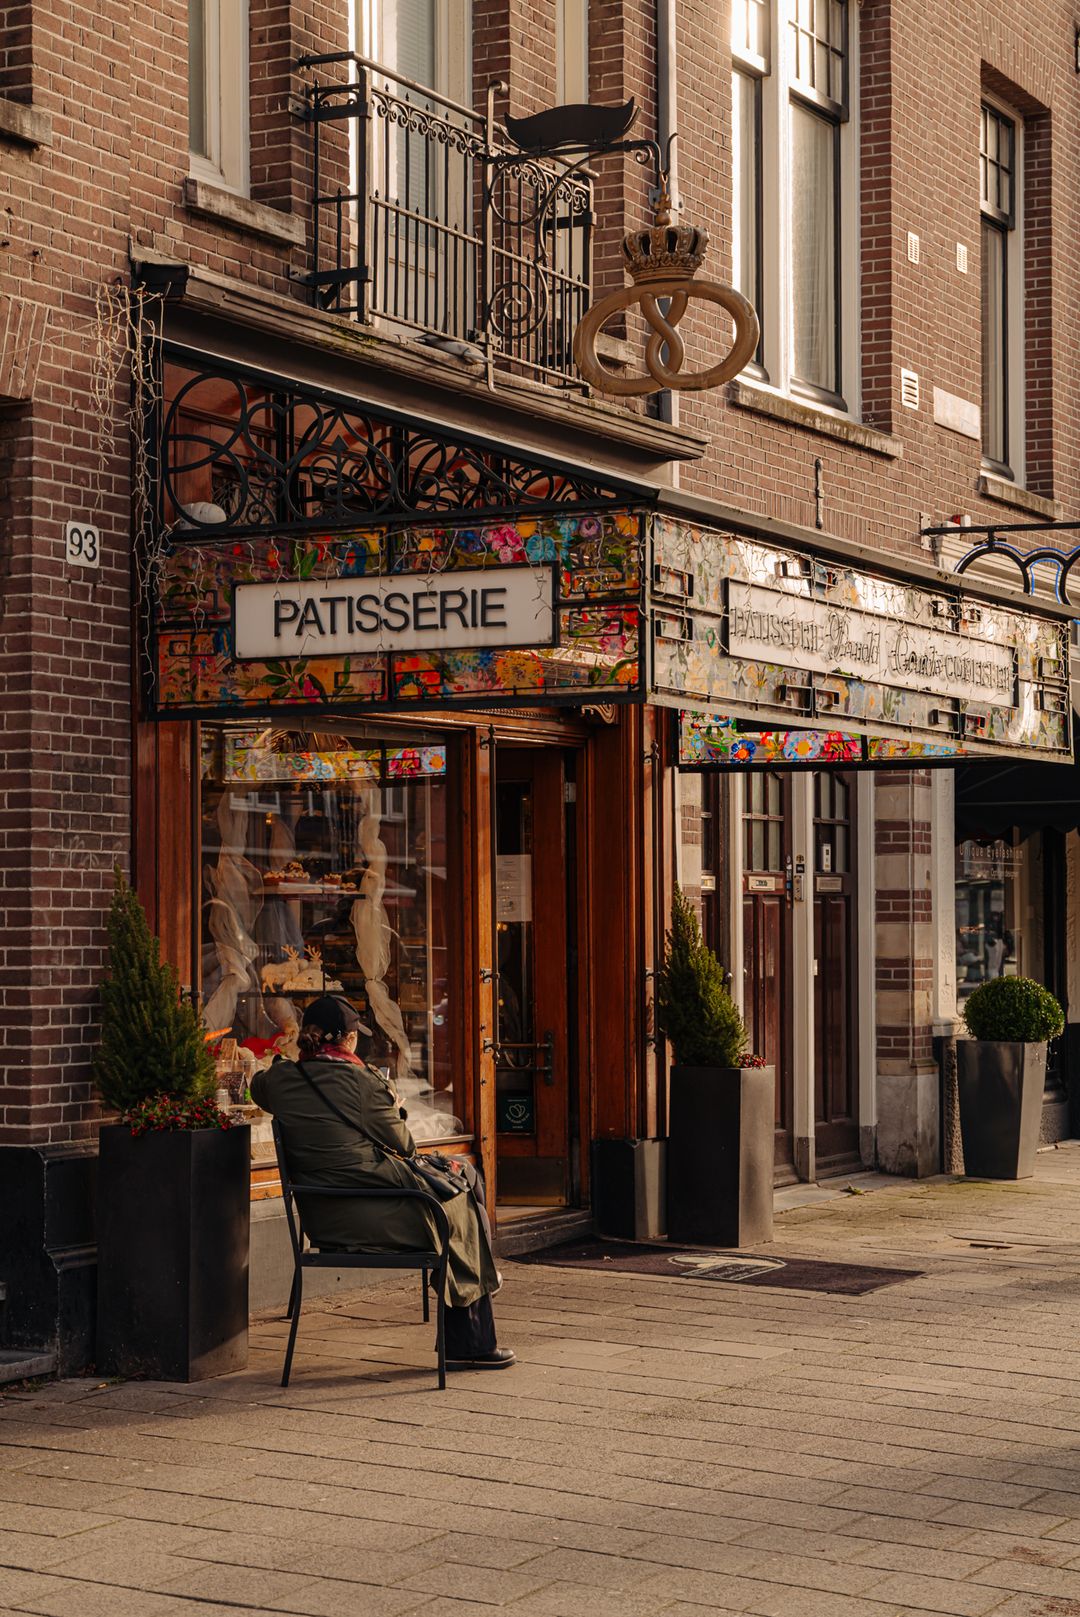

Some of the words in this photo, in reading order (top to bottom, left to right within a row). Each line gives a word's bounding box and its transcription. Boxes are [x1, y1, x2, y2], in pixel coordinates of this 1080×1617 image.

[69, 528, 97, 562] 93
[274, 588, 509, 638] PATISSERIE
[959, 844, 983, 860] Unique
